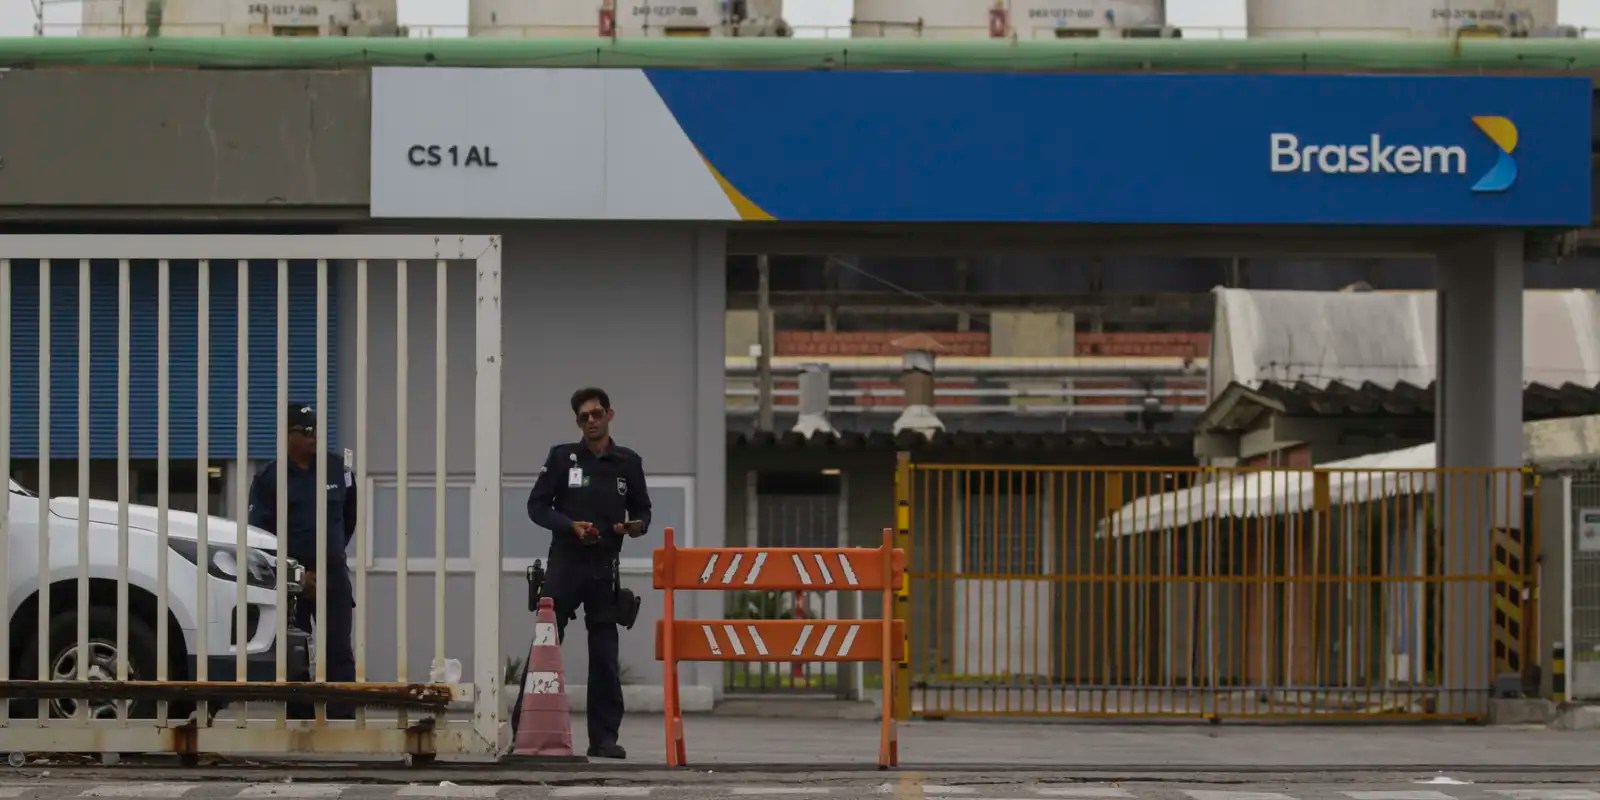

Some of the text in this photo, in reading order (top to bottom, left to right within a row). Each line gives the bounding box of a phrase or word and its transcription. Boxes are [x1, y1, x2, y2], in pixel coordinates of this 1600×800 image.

[408, 145, 498, 167] CS 1 AL
[1270, 133, 1467, 174] Braskem
